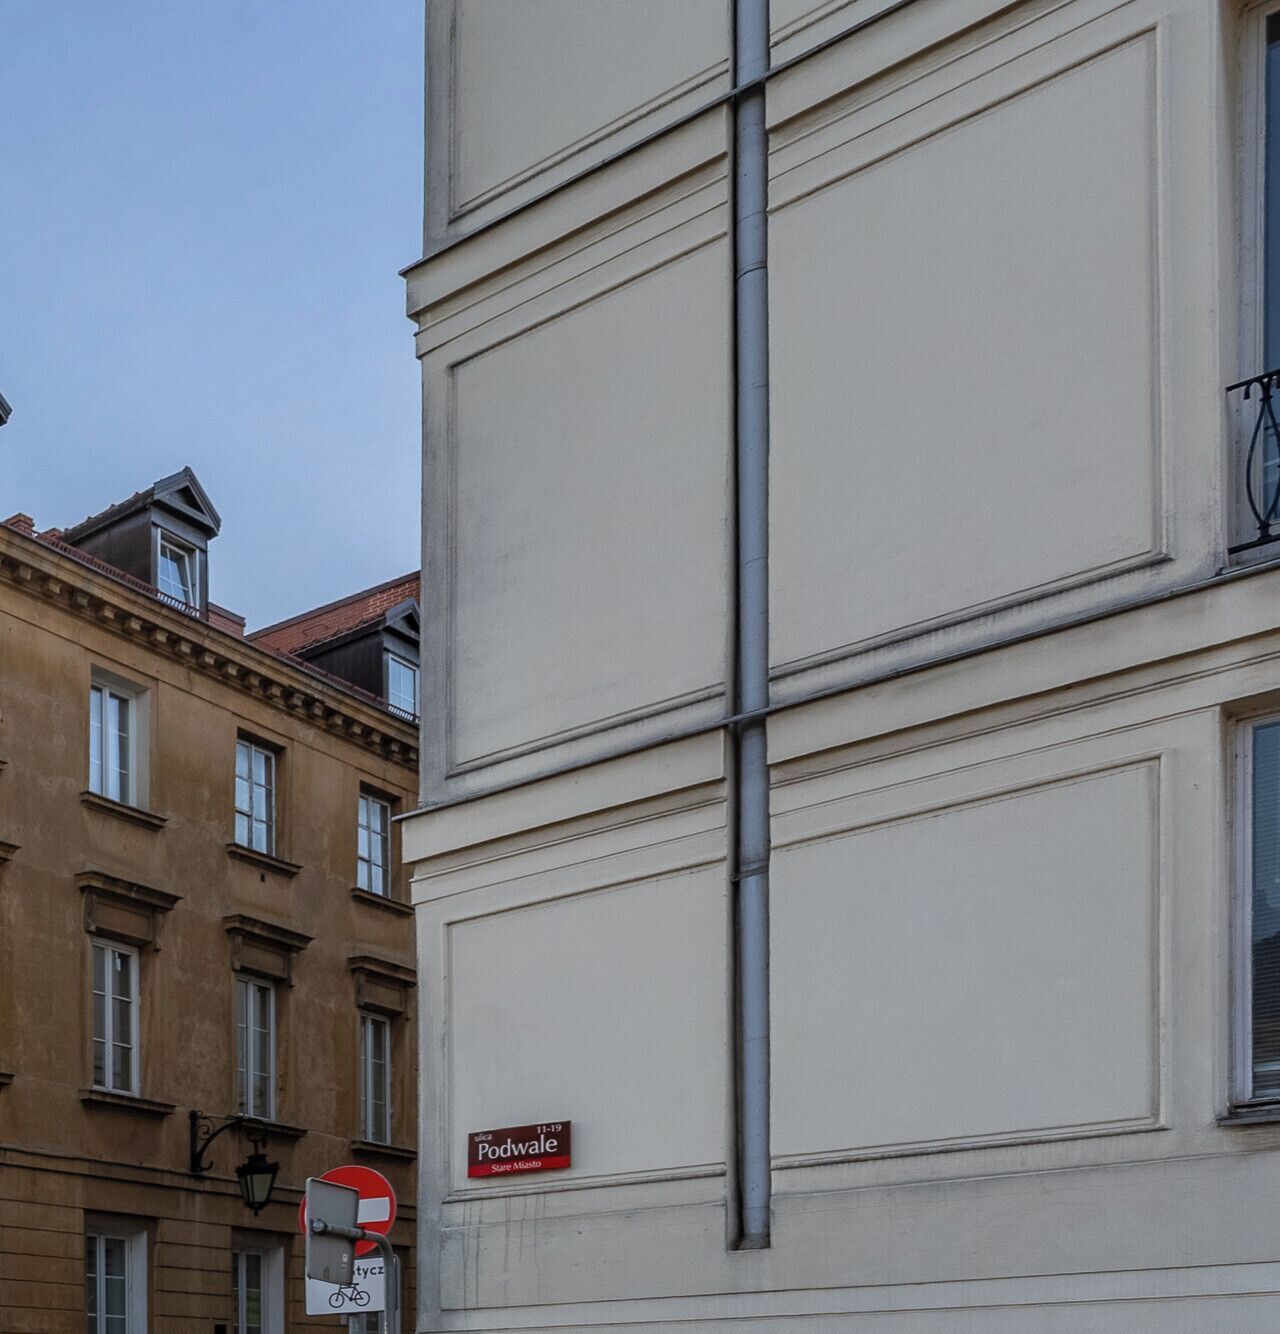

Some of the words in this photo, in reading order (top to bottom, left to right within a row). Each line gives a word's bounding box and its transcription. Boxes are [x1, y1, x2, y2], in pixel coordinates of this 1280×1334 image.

[536, 1124, 562, 1134] 11-19
[474, 1133, 492, 1142] ulica
[478, 1134, 558, 1161] Podwale
[491, 1163, 512, 1173] Stare
[513, 1160, 542, 1170] Miasto
[353, 1265, 384, 1280] tycz
